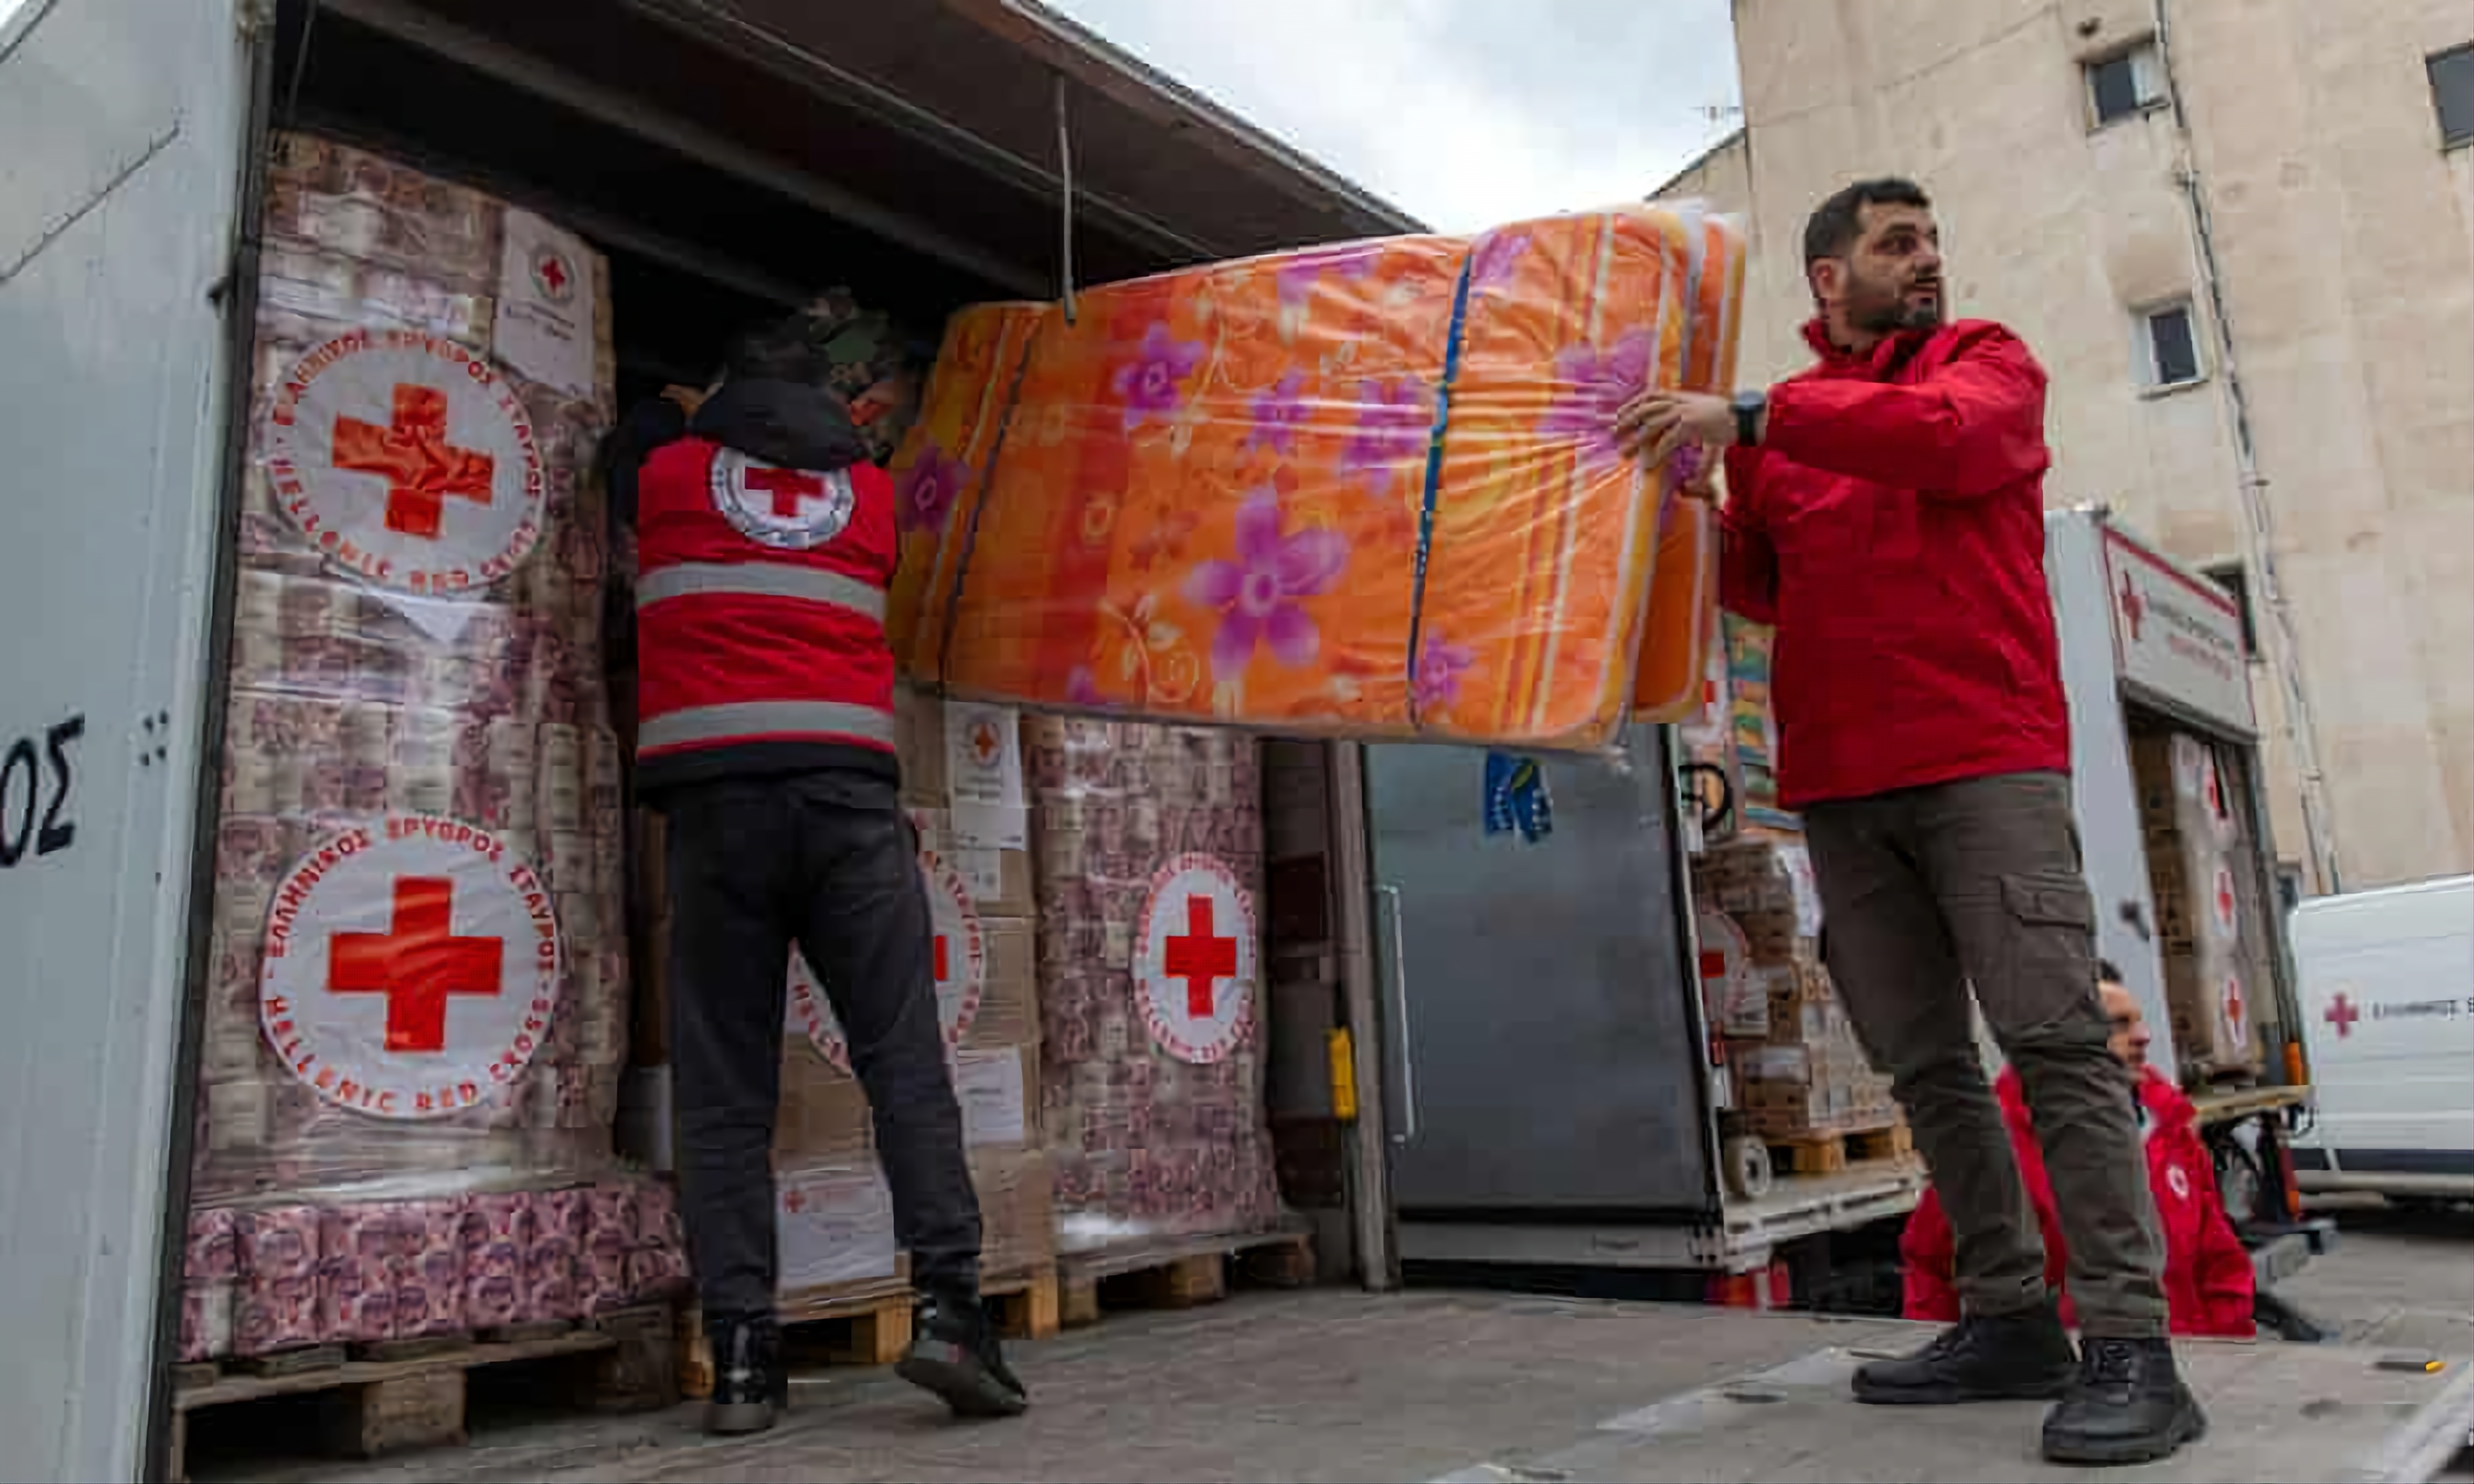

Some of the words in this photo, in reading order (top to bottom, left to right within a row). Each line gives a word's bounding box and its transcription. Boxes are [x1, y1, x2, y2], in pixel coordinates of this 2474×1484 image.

[265, 995, 396, 1113] HELLENIC
[413, 1080, 478, 1111] RED
[489, 998, 551, 1081] CROSS
